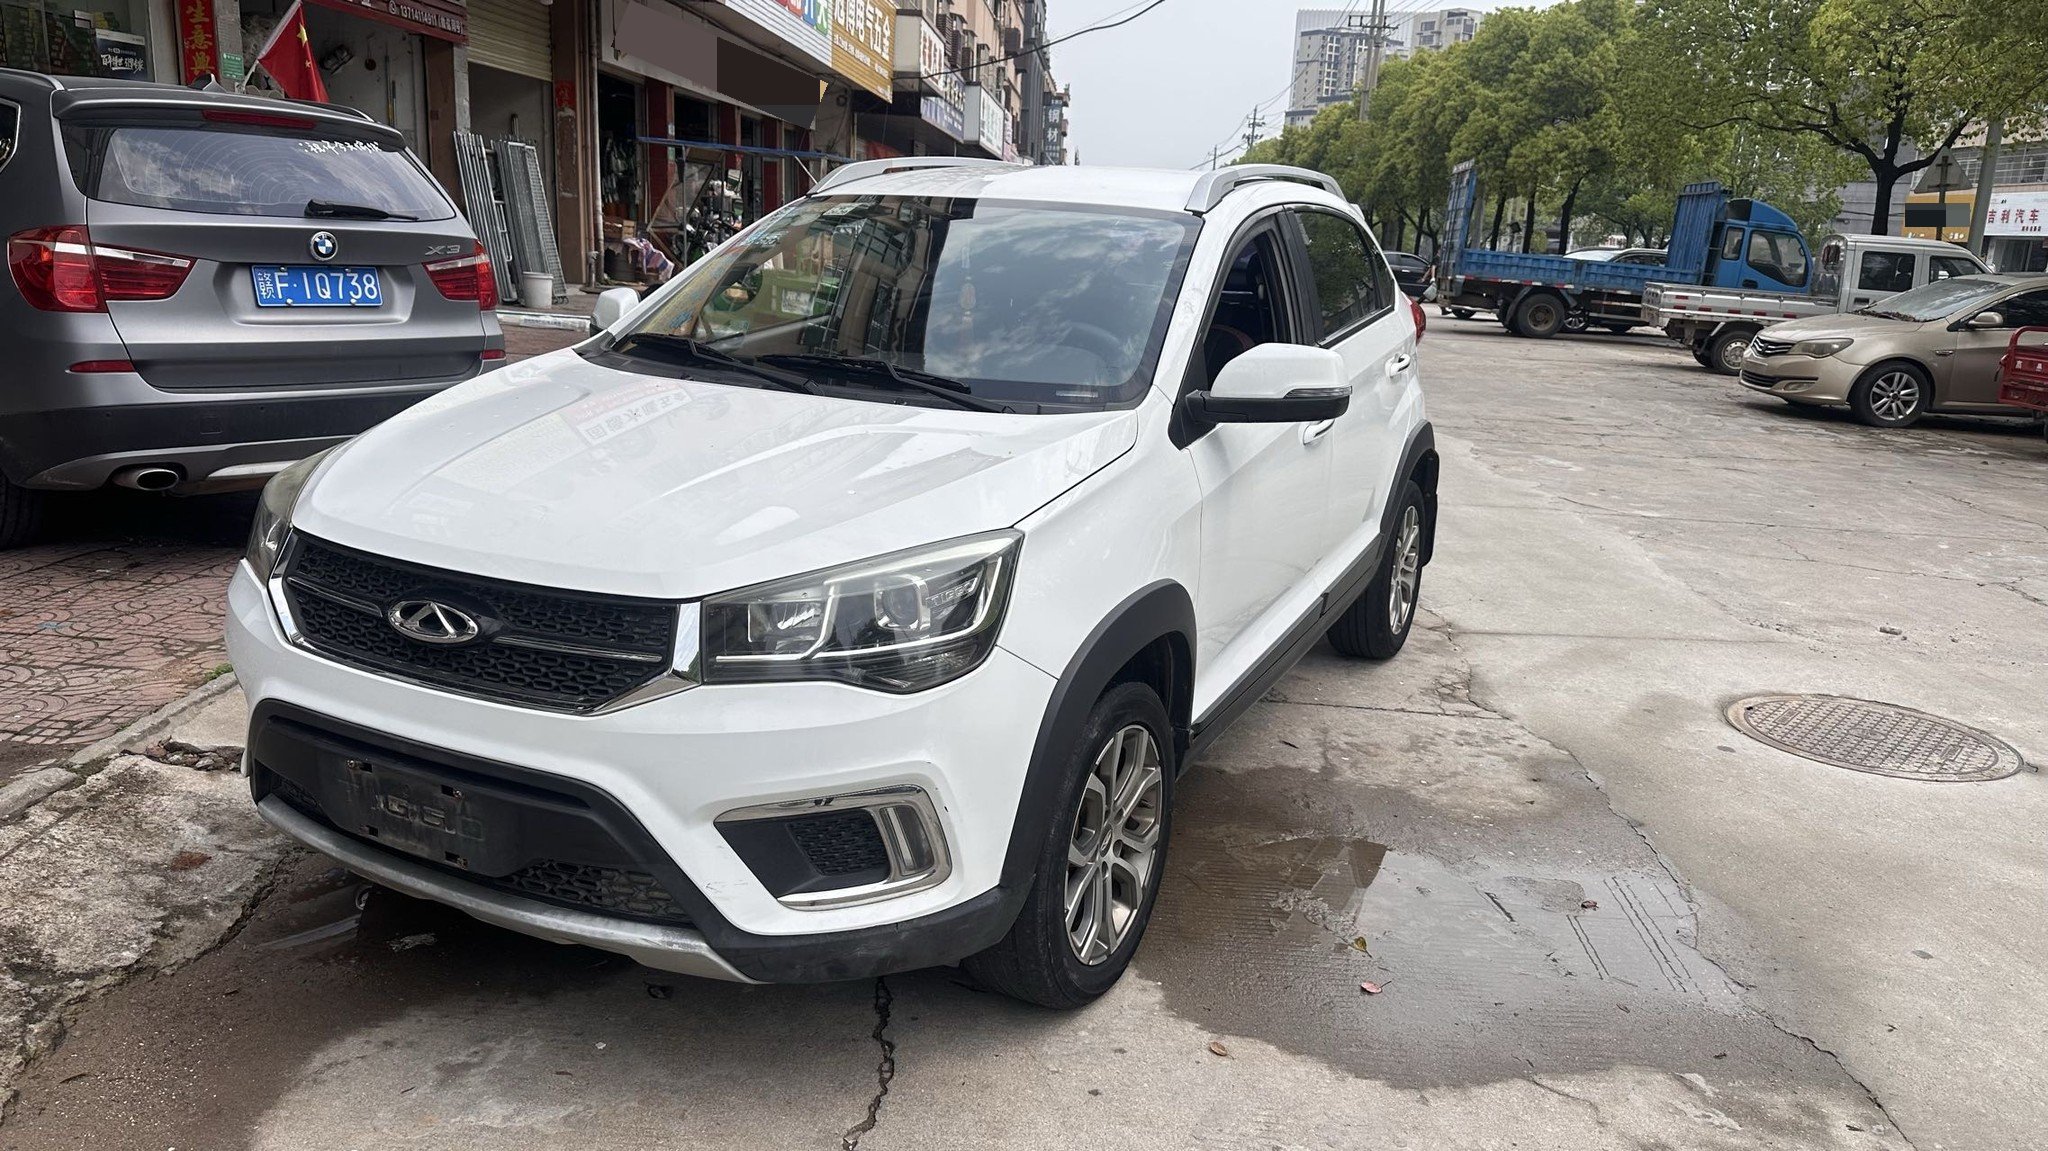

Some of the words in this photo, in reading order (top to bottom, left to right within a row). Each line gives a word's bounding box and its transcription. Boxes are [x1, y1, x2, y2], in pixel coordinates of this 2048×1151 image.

[1987, 208, 2040, 224] 吉利汽车
[425, 244, 461, 256] X3
